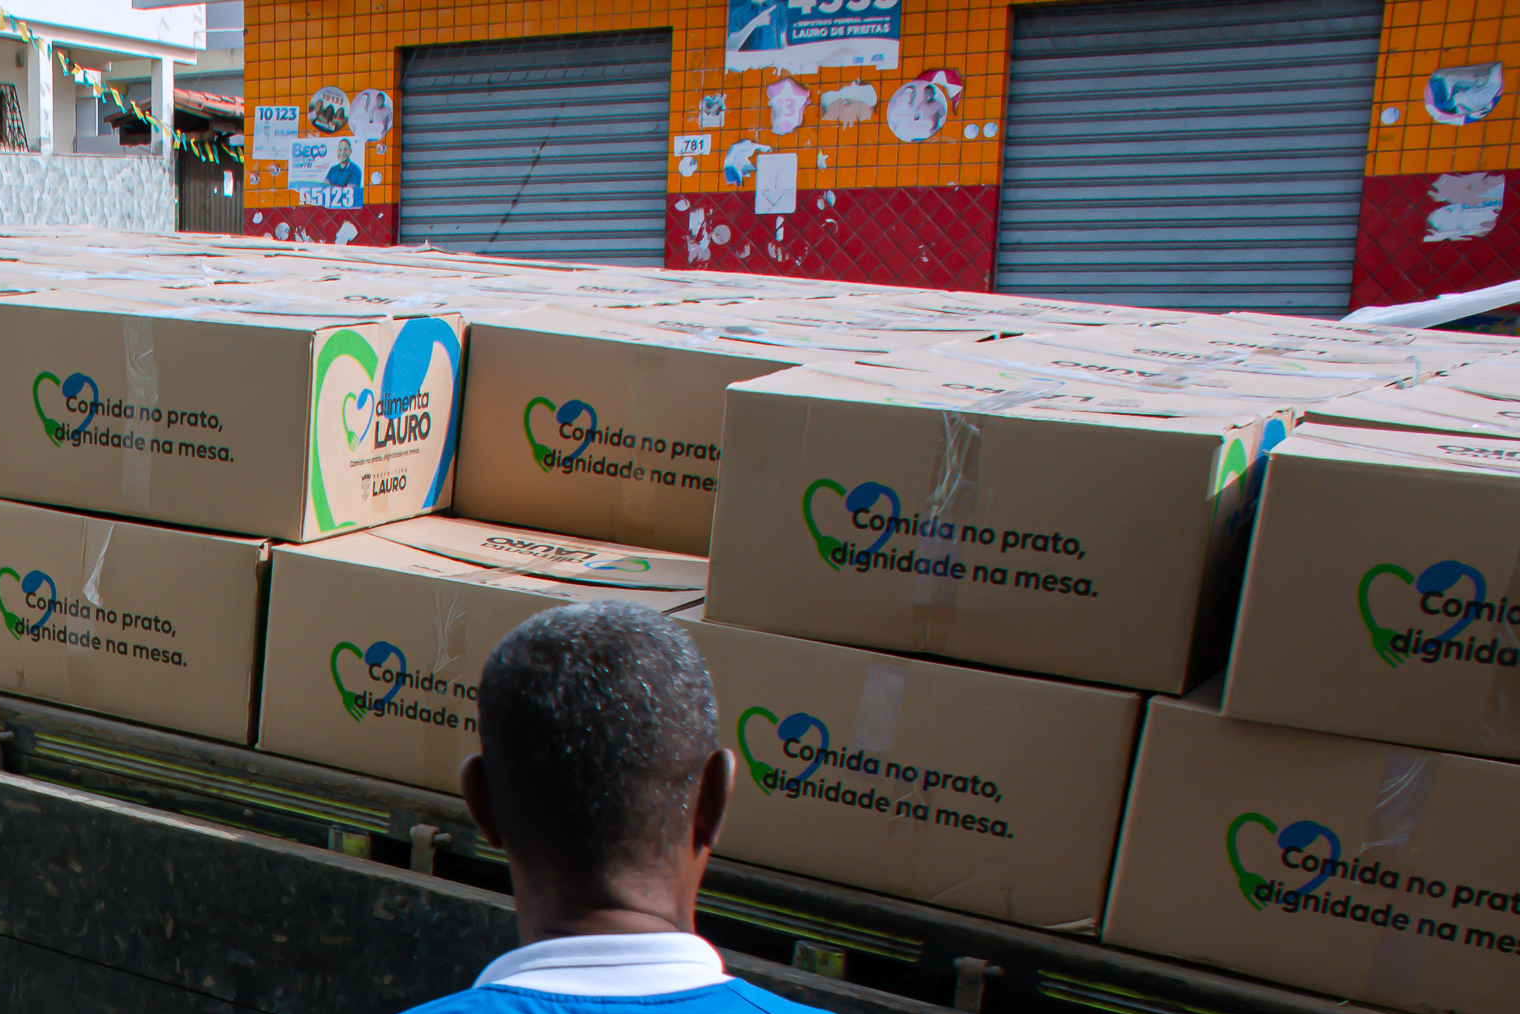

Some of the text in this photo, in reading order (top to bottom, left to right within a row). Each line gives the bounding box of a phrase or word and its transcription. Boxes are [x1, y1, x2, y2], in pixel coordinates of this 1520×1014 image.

[792, 23, 890, 39] LAURO DE FREITAS
[683, 139, 704, 151] 781
[66, 395, 223, 433] Comida no prato,
[376, 390, 429, 417] alimenta
[54, 422, 234, 463] dignidade na mesa.
[374, 412, 431, 450] LAURO
[559, 421, 634, 448] Comida
[641, 437, 666, 453] no
[372, 475, 406, 497] LAURO
[543, 449, 719, 492] dignidade na me
[851, 507, 1086, 561] Comida no prato,
[831, 541, 1099, 598] dignidade na mesa.
[26, 592, 177, 638] Comida no prato,
[15, 617, 187, 667] dignidade na mesa.
[368, 662, 478, 701] Comida no
[354, 690, 478, 732] dignidade n
[782, 737, 1002, 803] Comida no prato,
[762, 768, 1014, 839] dignidade na mesa.
[1281, 845, 1400, 889] Comida
[1407, 874, 1446, 899] no
[1254, 879, 1410, 931] dignidade
[1417, 916, 1458, 942] na
